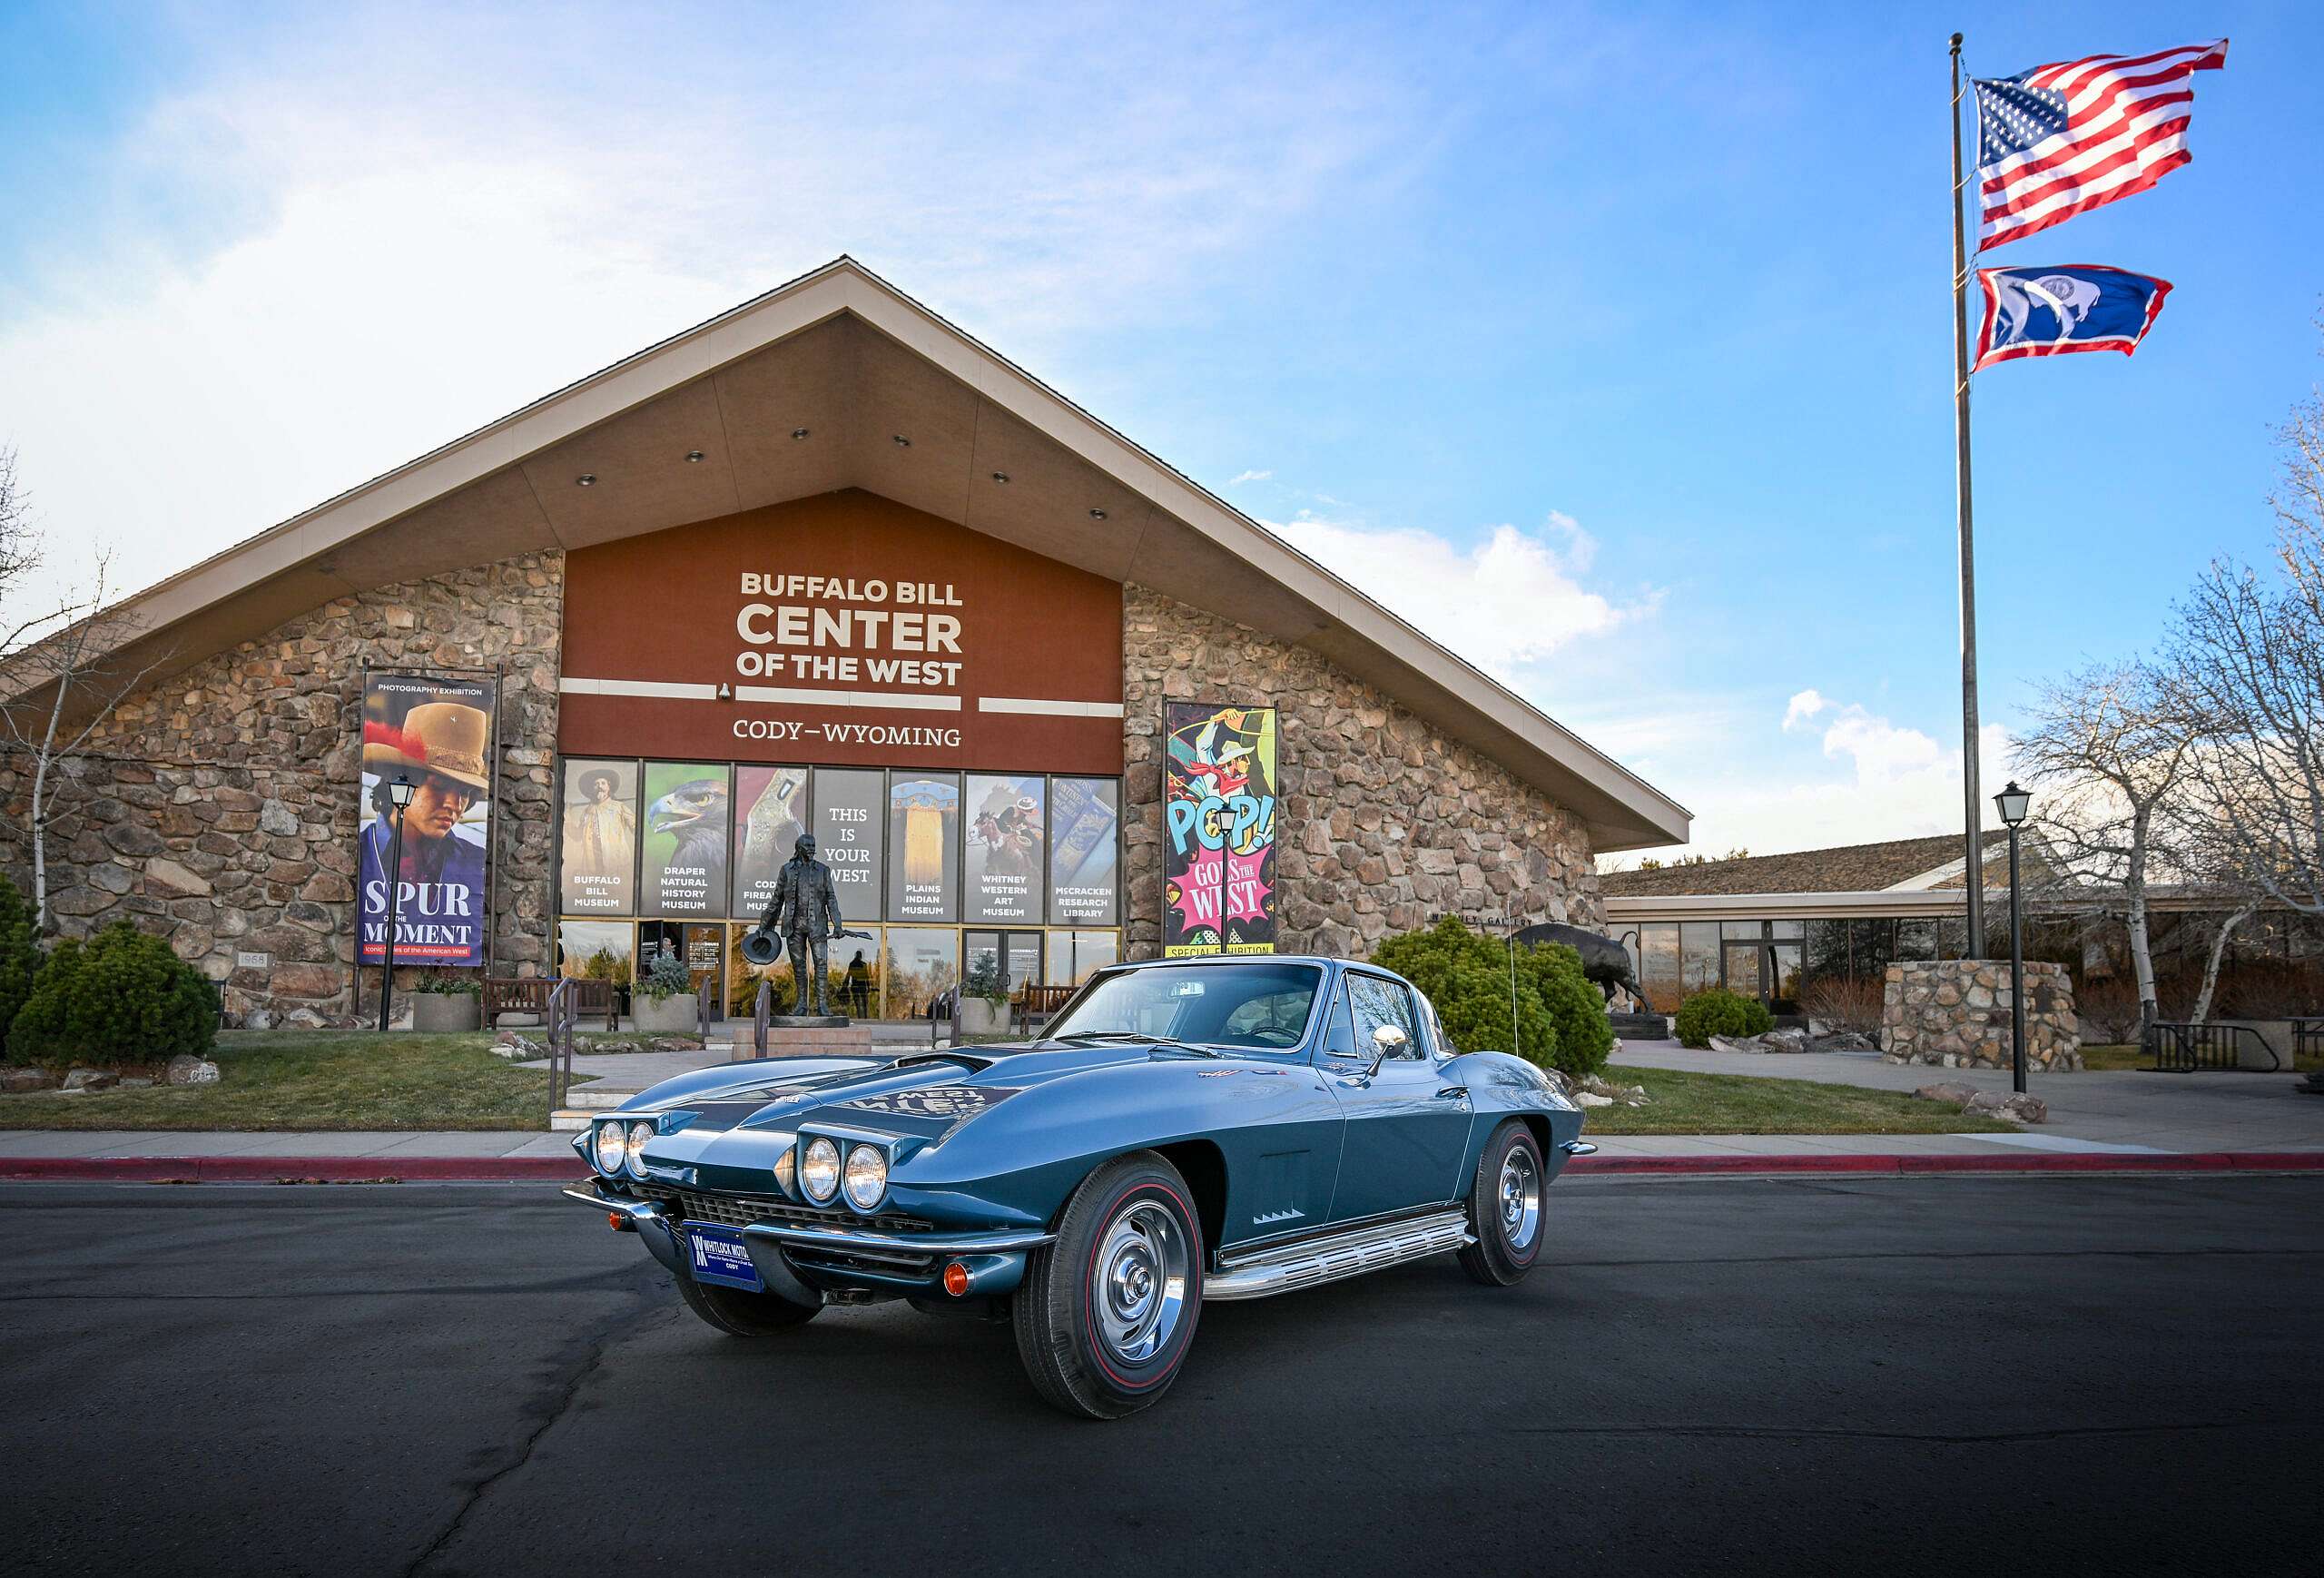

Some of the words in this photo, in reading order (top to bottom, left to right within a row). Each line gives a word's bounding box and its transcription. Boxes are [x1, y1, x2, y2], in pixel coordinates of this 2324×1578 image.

[741, 572, 889, 603] BUFFALO
[896, 581, 963, 607] BILL
[736, 603, 962, 654] CENTER
[736, 651, 784, 677] OF
[791, 654, 858, 681] THE
[865, 658, 962, 686] WEST
[378, 684, 438, 694] PHOTOGRAPHY
[439, 687, 482, 696] EXHIBITION
[829, 807, 868, 823] THIS
[1167, 794, 1275, 856] POP!
[840, 828, 855, 842] IS
[824, 848, 871, 863] YOUR
[664, 867, 706, 876] DRAPER
[1238, 863, 1255, 879] THE
[574, 876, 621, 885] BUFFALO
[660, 878, 708, 887] NATURAL
[981, 875, 1027, 884] WHITNEY
[754, 880, 777, 889] COD
[906, 884, 941, 893] PLAINS
[586, 887, 608, 895] BILL
[661, 889, 706, 898] HISTORY
[981, 886, 1028, 895] WESTERN
[364, 880, 472, 917] SPUR
[743, 891, 774, 900] FIREA
[905, 895, 940, 904] INDIAN
[574, 898, 619, 907] MUSEUM
[661, 901, 706, 910] MUSEUM
[994, 897, 1014, 905] ART
[1059, 898, 1108, 907] RESEARCH
[901, 906, 944, 915] MUSEUM
[982, 908, 1025, 917] MUSEUM
[1063, 909, 1104, 918] LIBRARY
[363, 922, 472, 945] MOMENT
[1215, 946, 1270, 954] EHIBITION
[703, 1239, 733, 1256] WHITLOCK
[731, 1244, 750, 1258] MOTO
